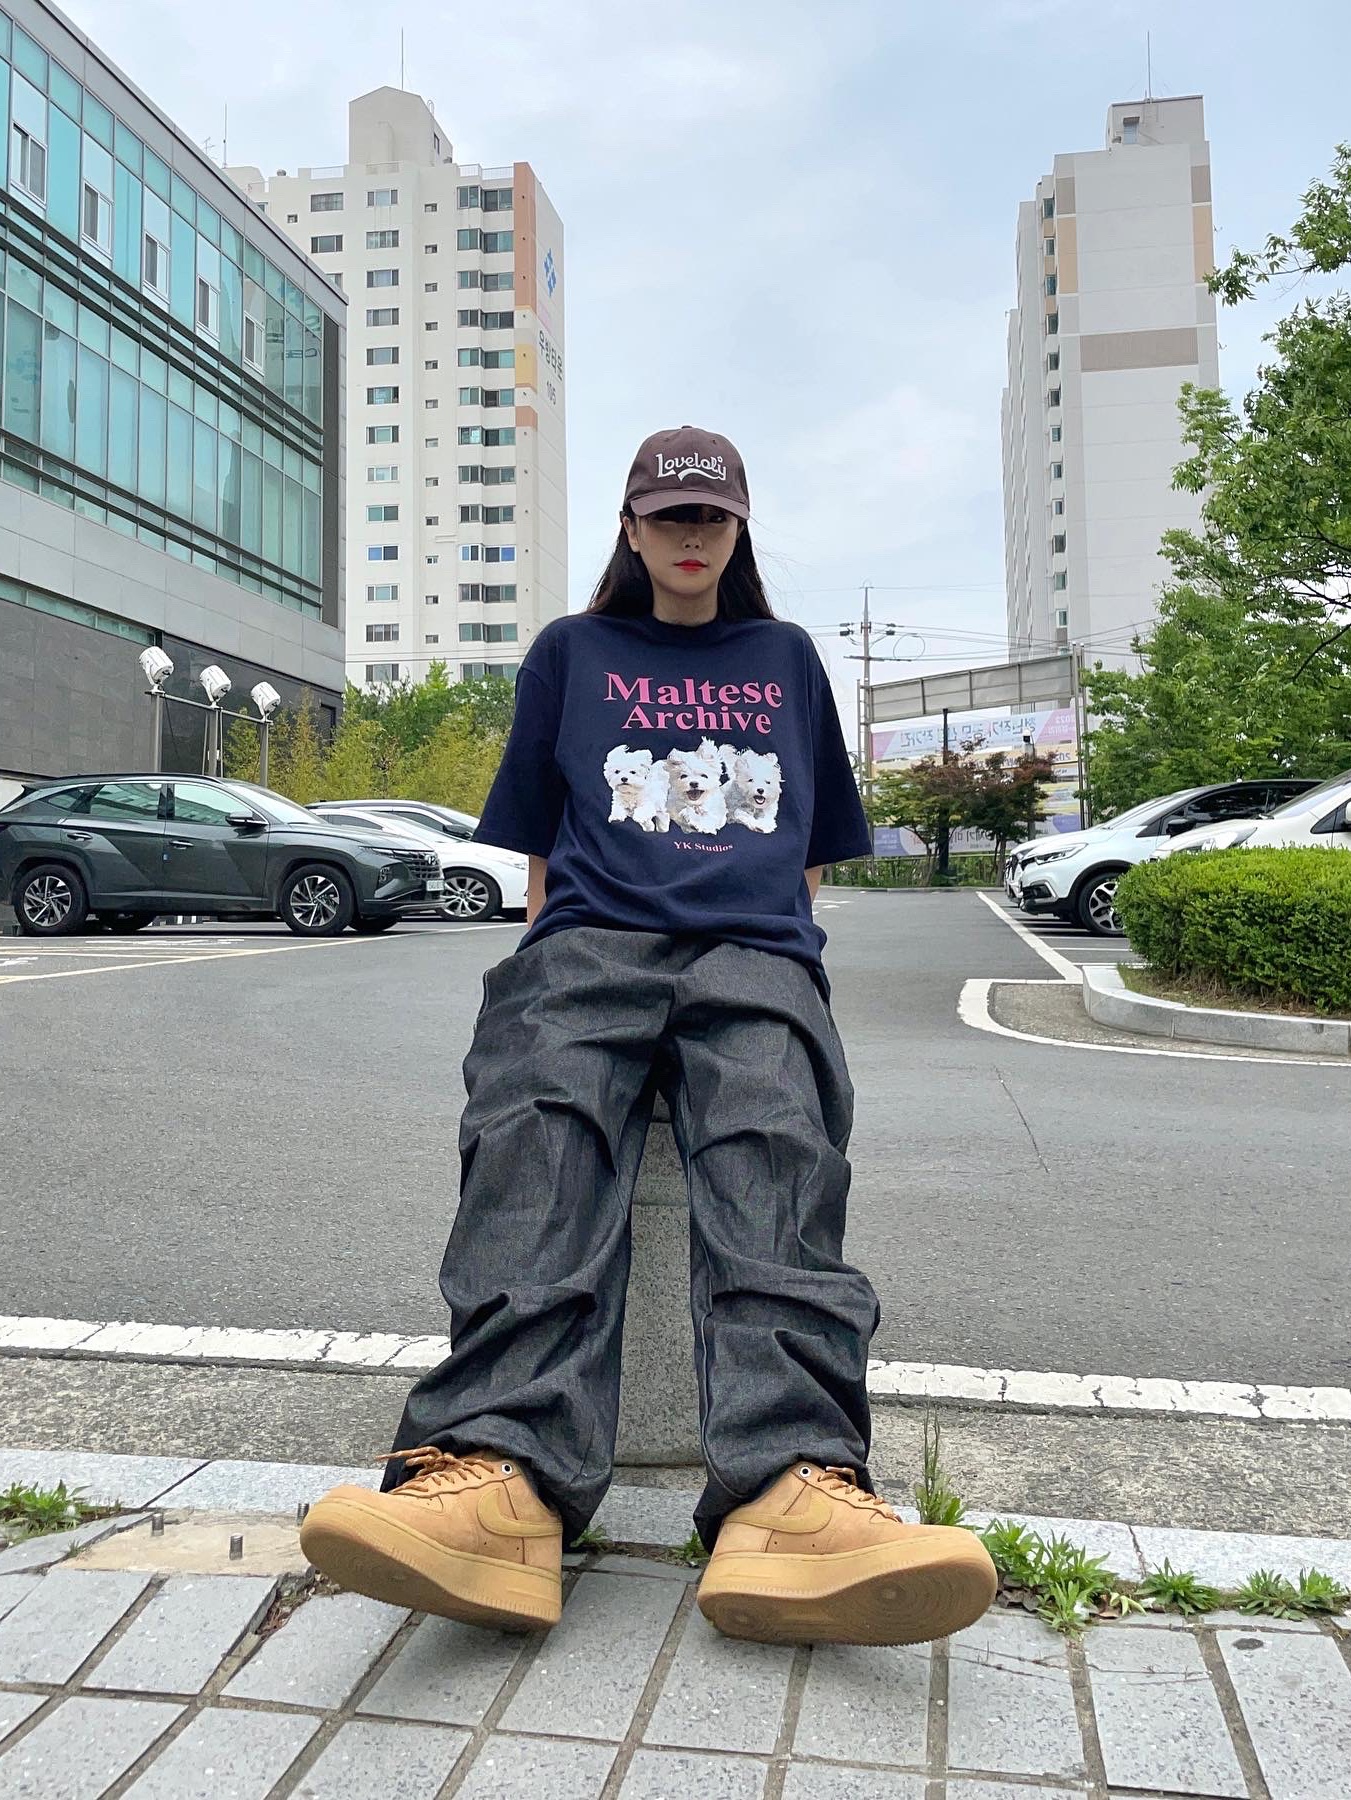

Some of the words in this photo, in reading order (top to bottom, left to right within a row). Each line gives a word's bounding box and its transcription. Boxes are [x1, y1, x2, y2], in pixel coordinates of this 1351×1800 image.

[603, 671, 783, 708] Maltese
[621, 705, 772, 734] Archive
[674, 841, 692, 850] YK
[694, 842, 734, 853] Studios
